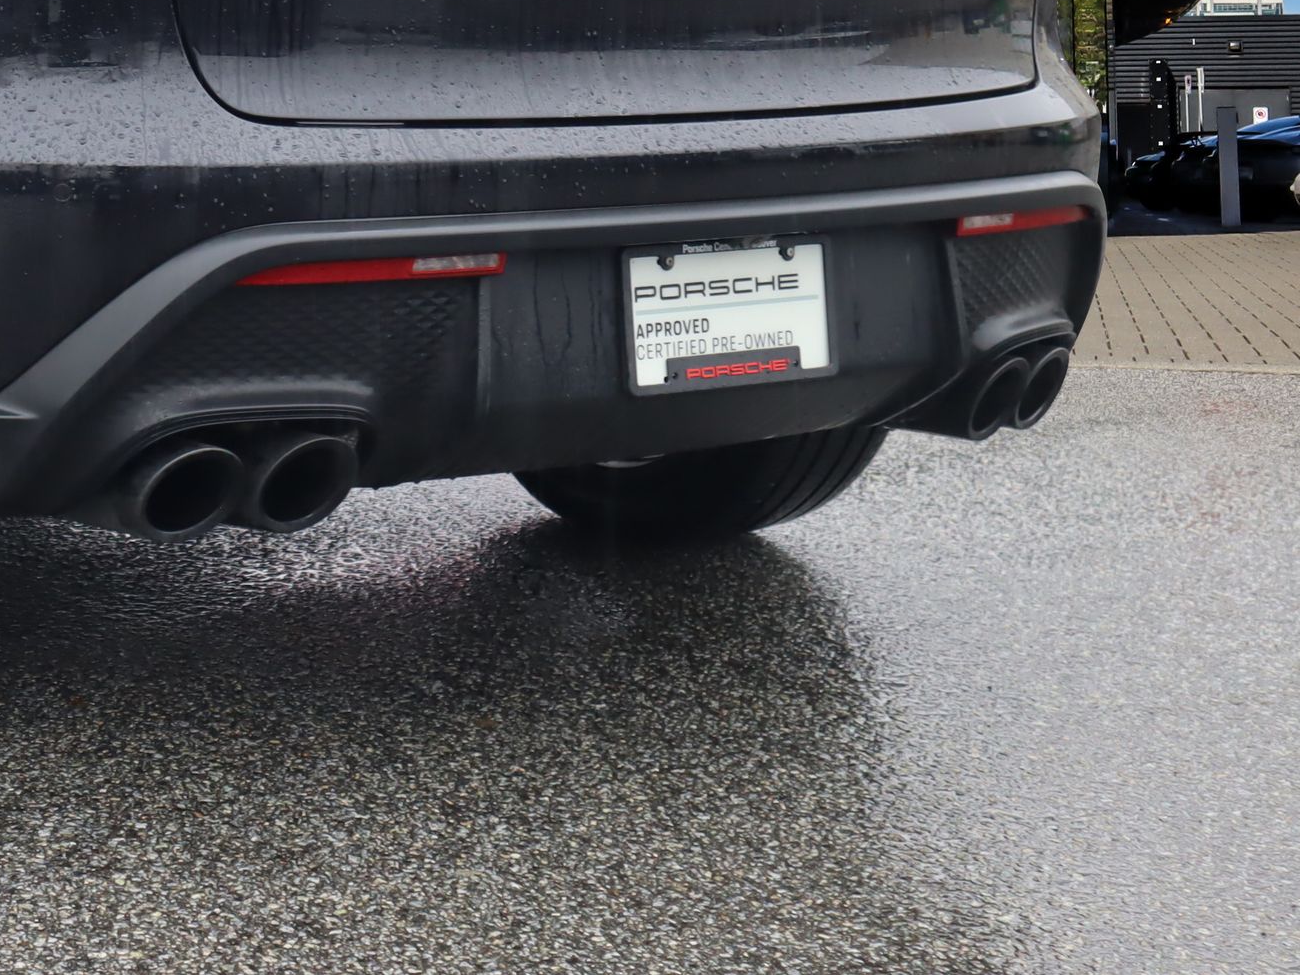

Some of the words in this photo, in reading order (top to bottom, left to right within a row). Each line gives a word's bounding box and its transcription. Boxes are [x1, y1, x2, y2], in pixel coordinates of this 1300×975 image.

[634, 273, 799, 303] PORSCHE
[636, 318, 710, 340] APPROVED
[636, 339, 708, 360] CERTIFIED
[711, 329, 794, 354] PRE-OWNED
[685, 358, 789, 381] PORSCHE
